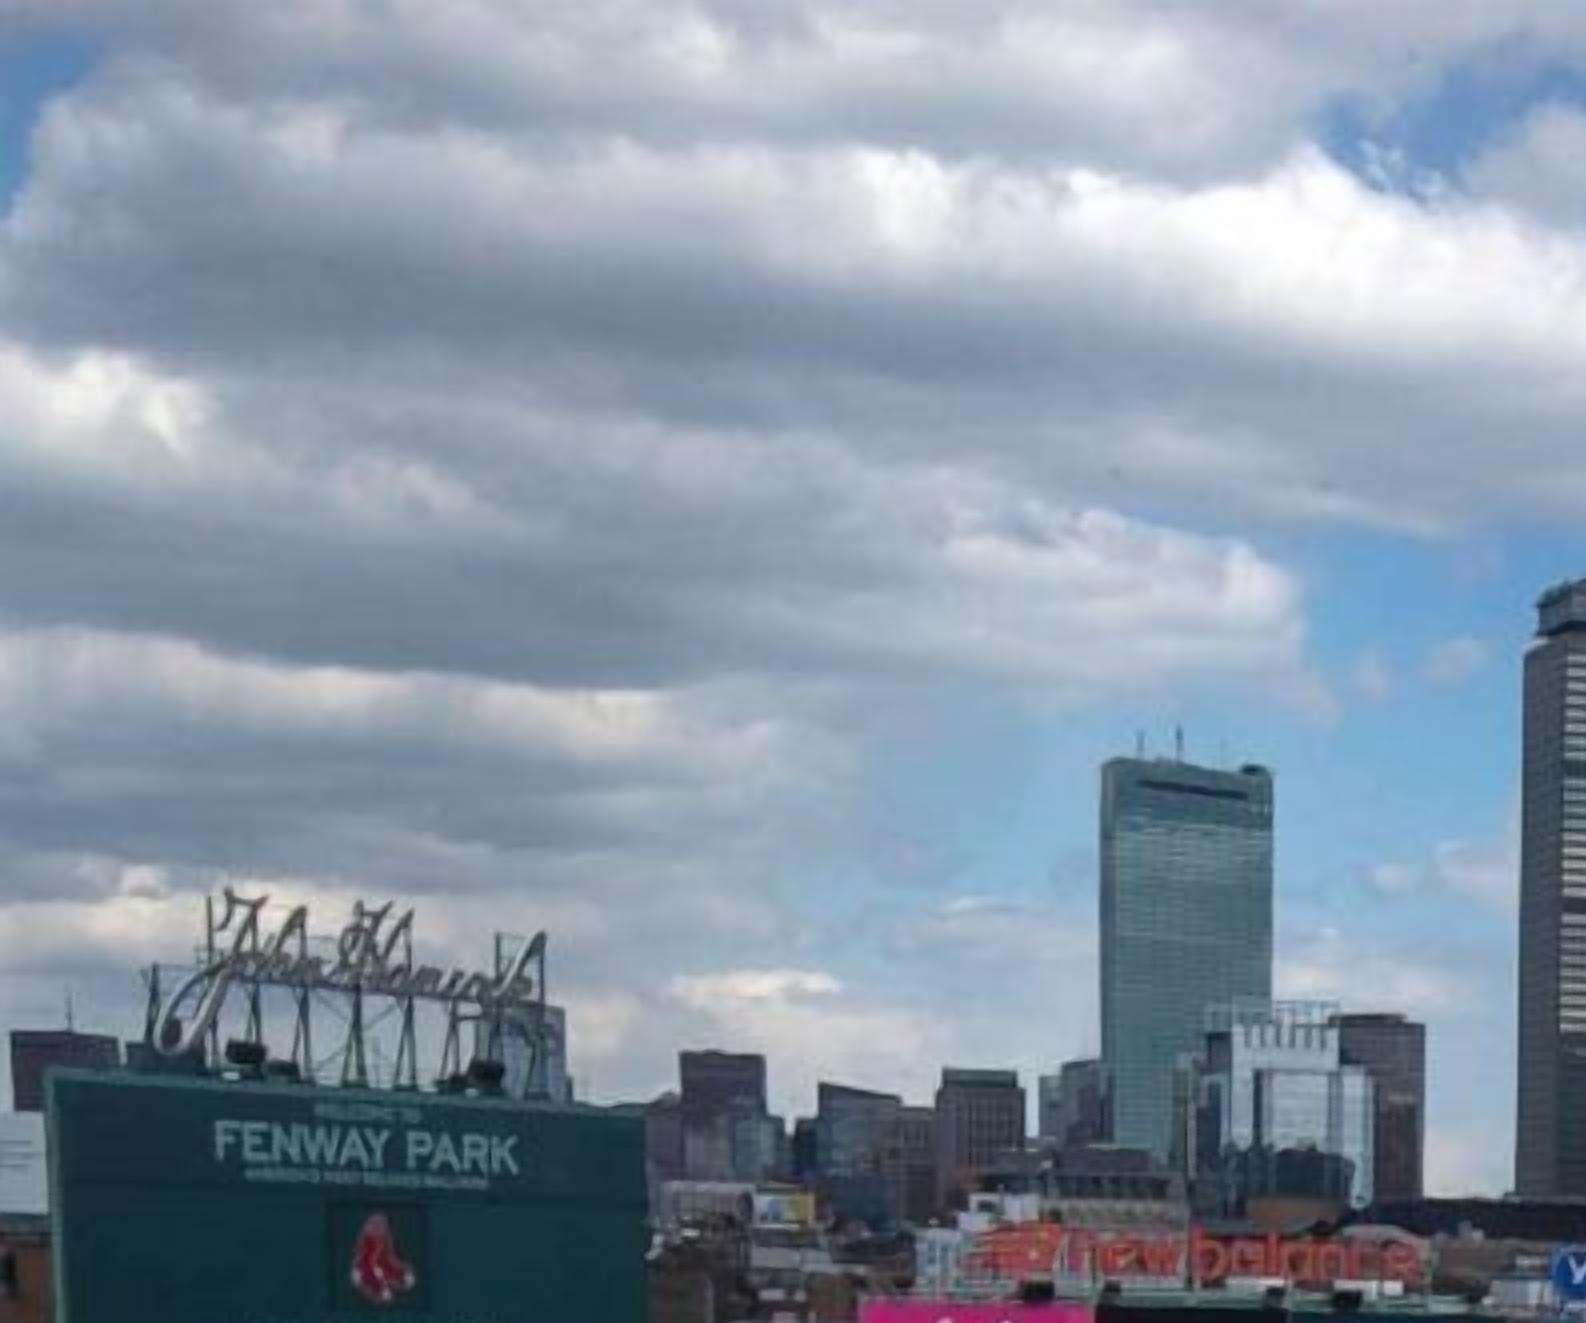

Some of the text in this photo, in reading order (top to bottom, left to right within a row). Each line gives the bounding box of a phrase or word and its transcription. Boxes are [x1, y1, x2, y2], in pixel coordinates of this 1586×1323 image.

[213, 1119, 520, 1177] FENWAY PARK
[1084, 1223, 1426, 1282] new balance
